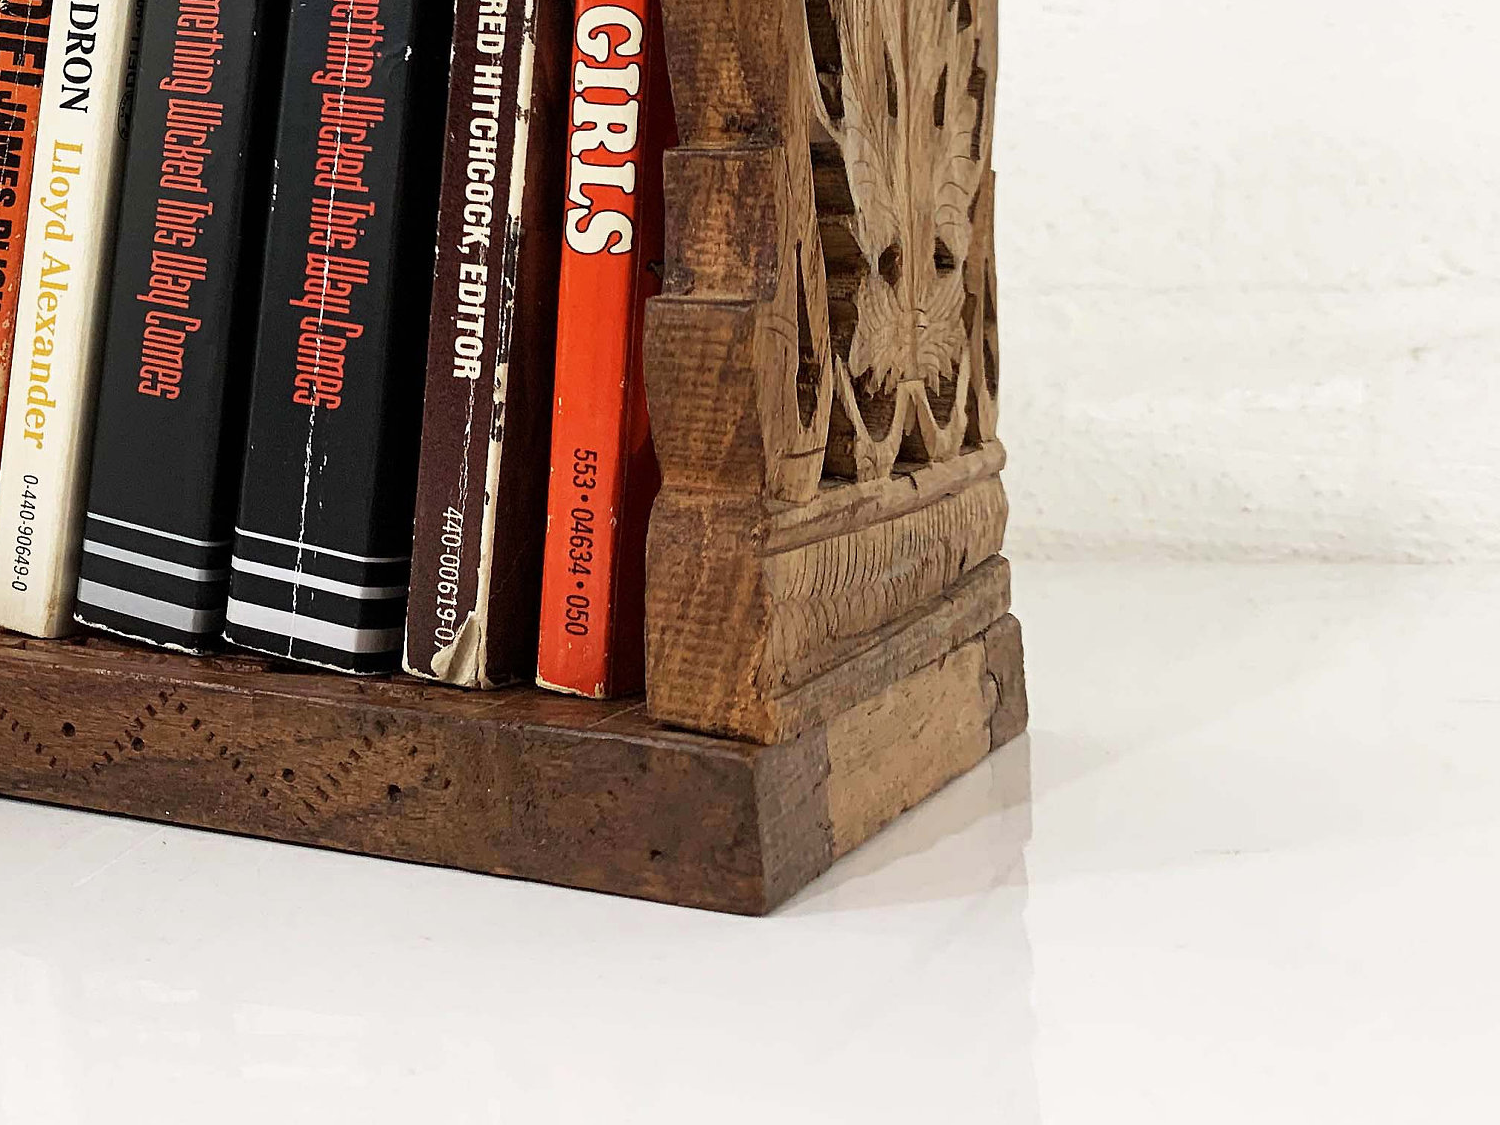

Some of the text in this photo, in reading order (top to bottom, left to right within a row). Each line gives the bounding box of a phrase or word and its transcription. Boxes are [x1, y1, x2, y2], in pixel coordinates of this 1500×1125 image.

[159, 98, 224, 193] Wicked
[314, 92, 385, 193] Wicked
[457, 63, 503, 254] HITCHCOCK,
[564, 4, 644, 256] GIRLS
[40, 139, 83, 243] Lloyd
[153, 198, 213, 248] This
[308, 197, 376, 250] This
[136, 250, 208, 310] Way
[289, 252, 370, 314] Way
[452, 262, 489, 381] EDITOR
[24, 251, 71, 450] Alexander
[137, 310, 202, 400] Comes
[292, 315, 364, 411] Comes
[11, 474, 39, 593] 0-440-90649-0
[565, 447, 598, 637] 553 04634 050
